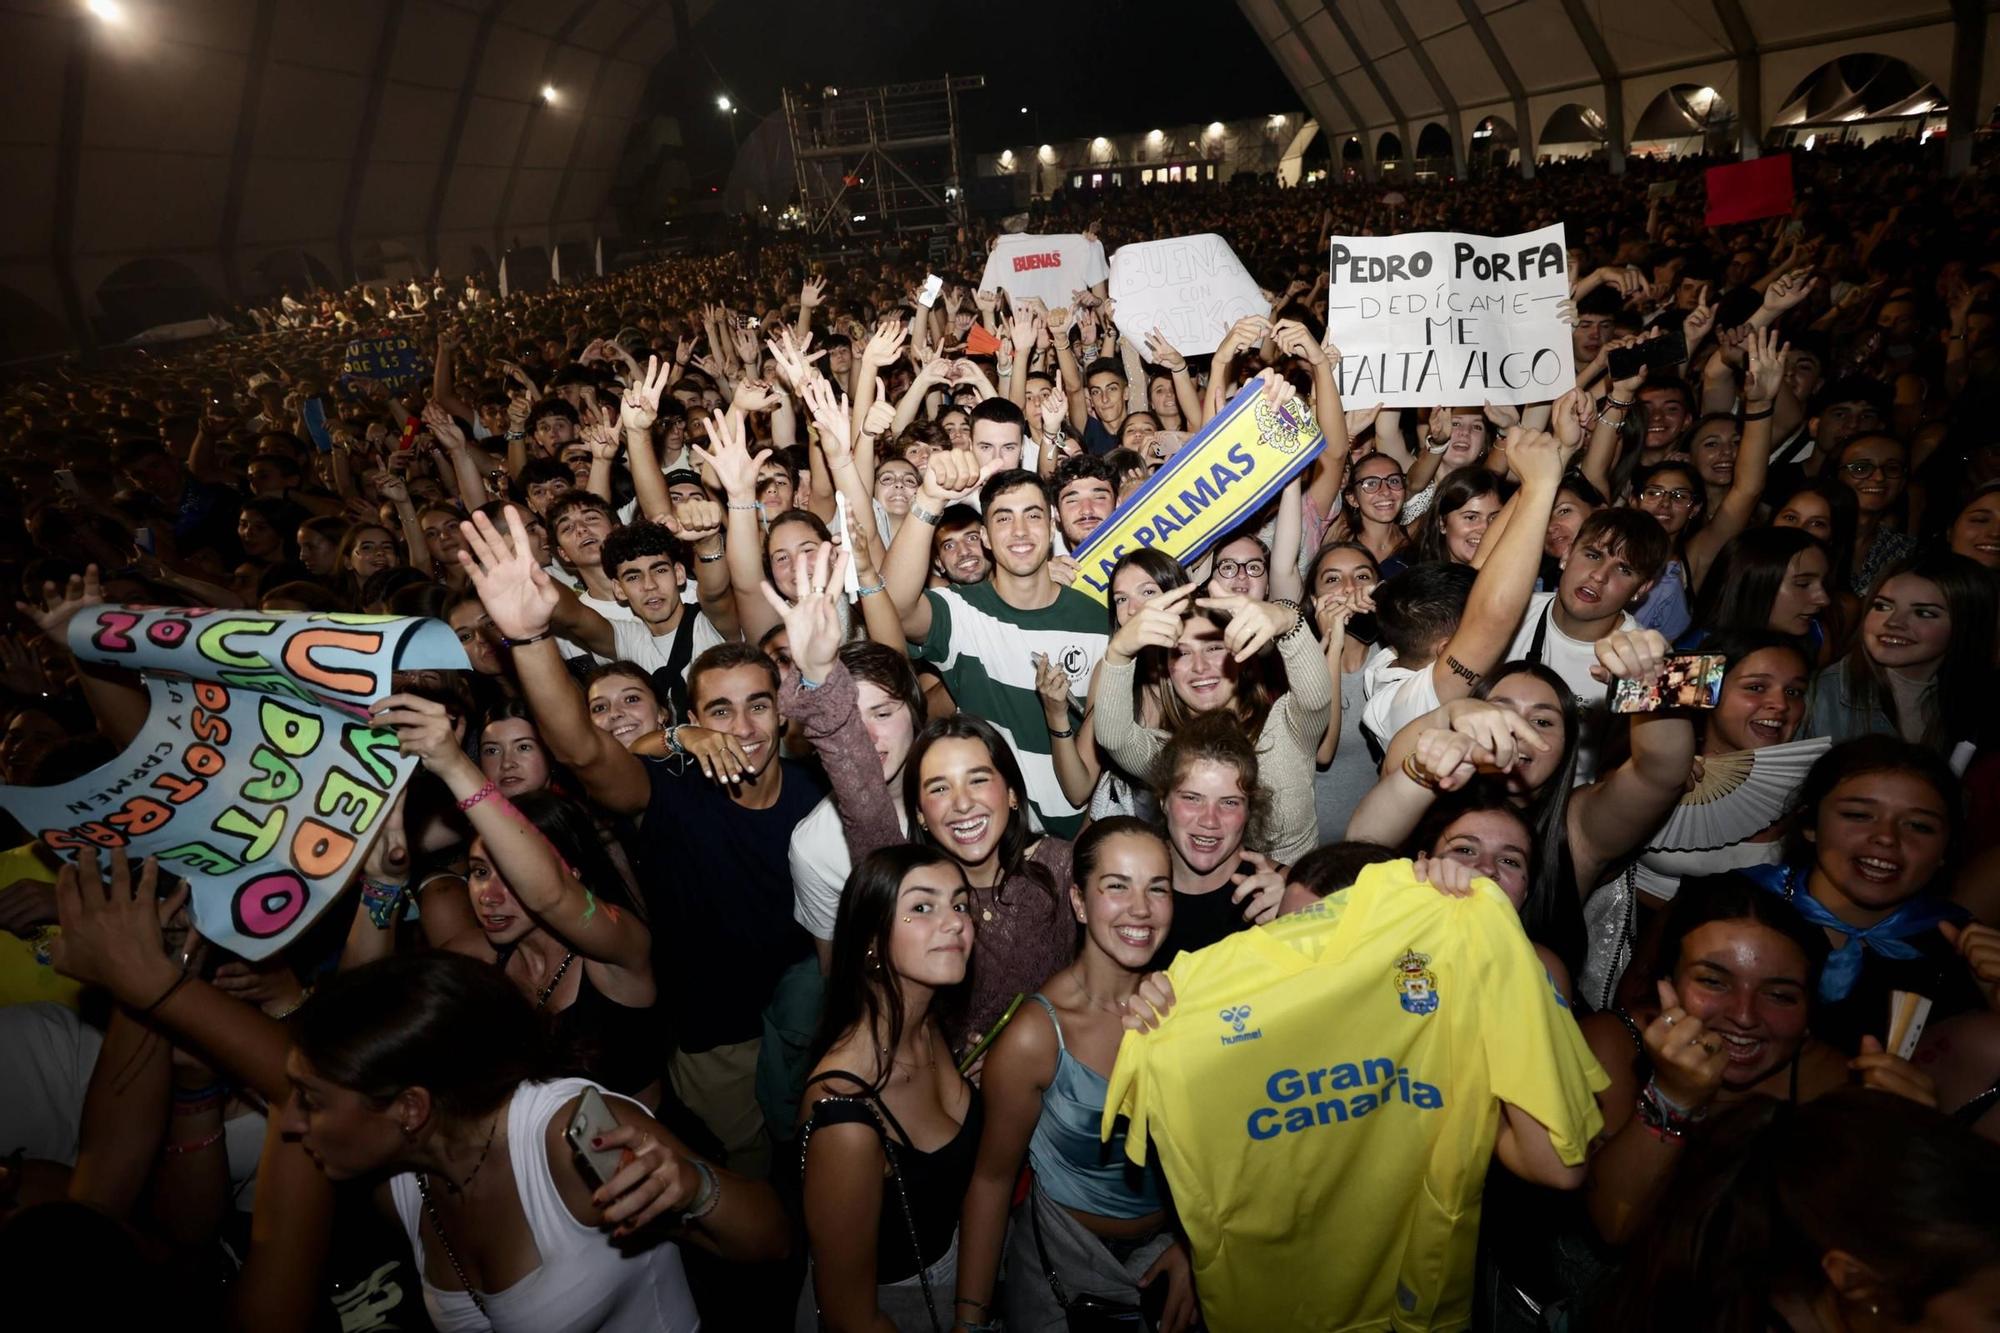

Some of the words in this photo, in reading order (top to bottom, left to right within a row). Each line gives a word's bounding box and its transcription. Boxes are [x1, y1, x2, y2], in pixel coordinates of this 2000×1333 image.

[1012, 253, 1061, 272] BUENAS
[1331, 243, 1433, 284] PEDRO
[1454, 242, 1564, 282] PORFA
[1178, 284, 1213, 303] CON
[1360, 282, 1529, 319] DEDÍCAME
[1425, 316, 1480, 346] ME
[1338, 349, 1443, 396] FALTA
[1459, 348, 1562, 390] ALGO
[1133, 442, 1255, 549] PALMAS
[65, 742, 173, 815] CARMEN
[1221, 1028, 1262, 1046] hummel
[1266, 1056, 1395, 1103] Gran
[1247, 1067, 1444, 1140] Canaria
